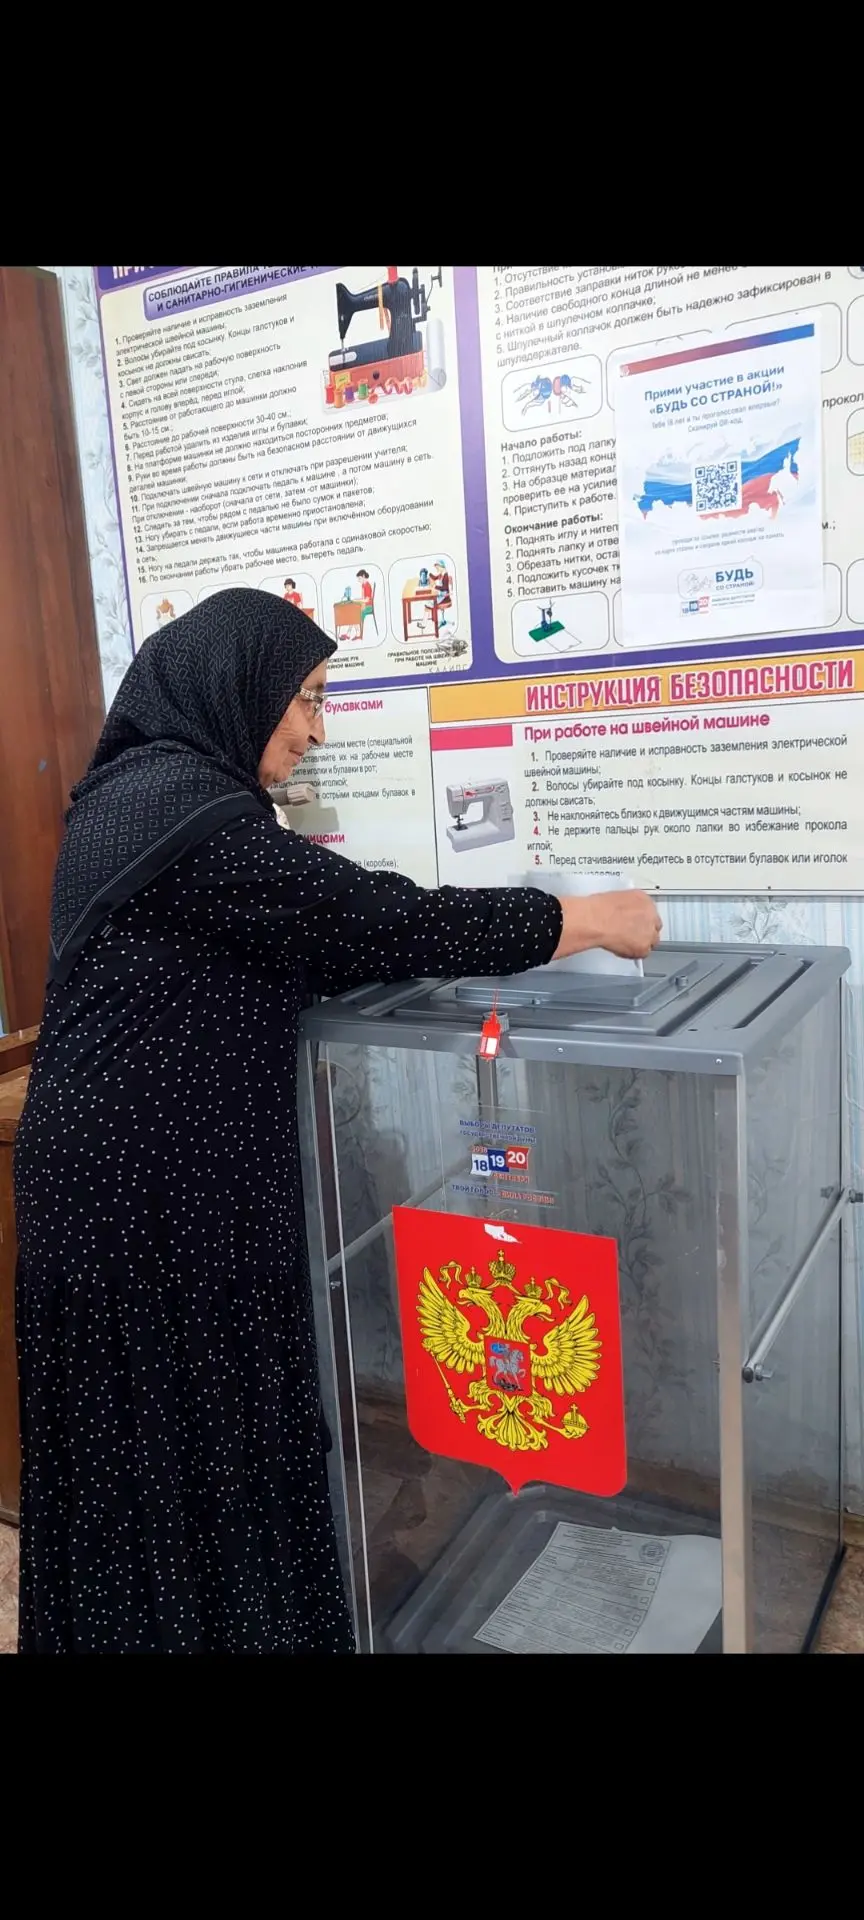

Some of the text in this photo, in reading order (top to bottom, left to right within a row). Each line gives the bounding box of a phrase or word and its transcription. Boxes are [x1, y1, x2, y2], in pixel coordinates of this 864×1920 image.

[148, 266, 260, 302] СОБЛЮДАЙТЕ ПРАВИЛА
[156, 302, 164, 313] И
[166, 266, 306, 310] САНИТАРНО-ГИГИЕНИЧЕСКИЕ
[566, 321, 611, 338] колпачок
[613, 311, 653, 329] должен
[655, 305, 683, 318] быть
[685, 292, 734, 311] надежно
[736, 272, 821, 300] зафиксирован
[824, 270, 831, 280] в
[644, 365, 784, 402] Прими участие в акции
[649, 380, 782, 414] «БУДЬ СО СТРАНОЙ!»
[500, 430, 582, 452] Начало работы:
[501, 437, 616, 465] 1. Подложить под лапку
[502, 489, 551, 505] проверить
[553, 486, 566, 496] ее
[568, 483, 580, 493] на
[503, 492, 616, 516] 4. Приступить к работе.
[503, 512, 603, 535] Окончание работы:
[505, 528, 587, 547] 1. Поднять иглу и
[505, 540, 594, 560] 2. Поднять лапку и
[505, 553, 593, 573] 3. Обрезать нитки,
[505, 564, 609, 584] 4. Подложить кусочек
[715, 567, 754, 583] БУДЬ
[506, 587, 515, 598] 5.
[517, 583, 567, 596] Поставить
[568, 578, 608, 590] машину
[525, 659, 854, 711] ИНСТРУКЦИЯ БЕЗОПАСНОСТИ
[324, 699, 383, 715] булавками
[524, 713, 770, 743] При работе на швейной машине
[346, 739, 366, 748] месте
[366, 734, 413, 749] (специальной
[530, 733, 847, 763] 1. Проверяйте наличие и исправность заземления электрической
[523, 764, 601, 777] швейной машины;
[531, 769, 848, 792] 2. Волосы убирайте под косынку. Концы галстуков и косынок не
[524, 796, 595, 808] должны свисать;
[532, 805, 801, 822] 3. Не наклоняйтесь близко к движущимся частям машины;
[532, 819, 847, 837] 4. Не держите пальцы рук около лапки во избежание прокола
[526, 840, 553, 851] иглой;
[534, 851, 847, 866] 5. Перед стачиванием убедитесь в отсутствии булавок или иголок
[474, 1151, 526, 1172] 18 19 20
